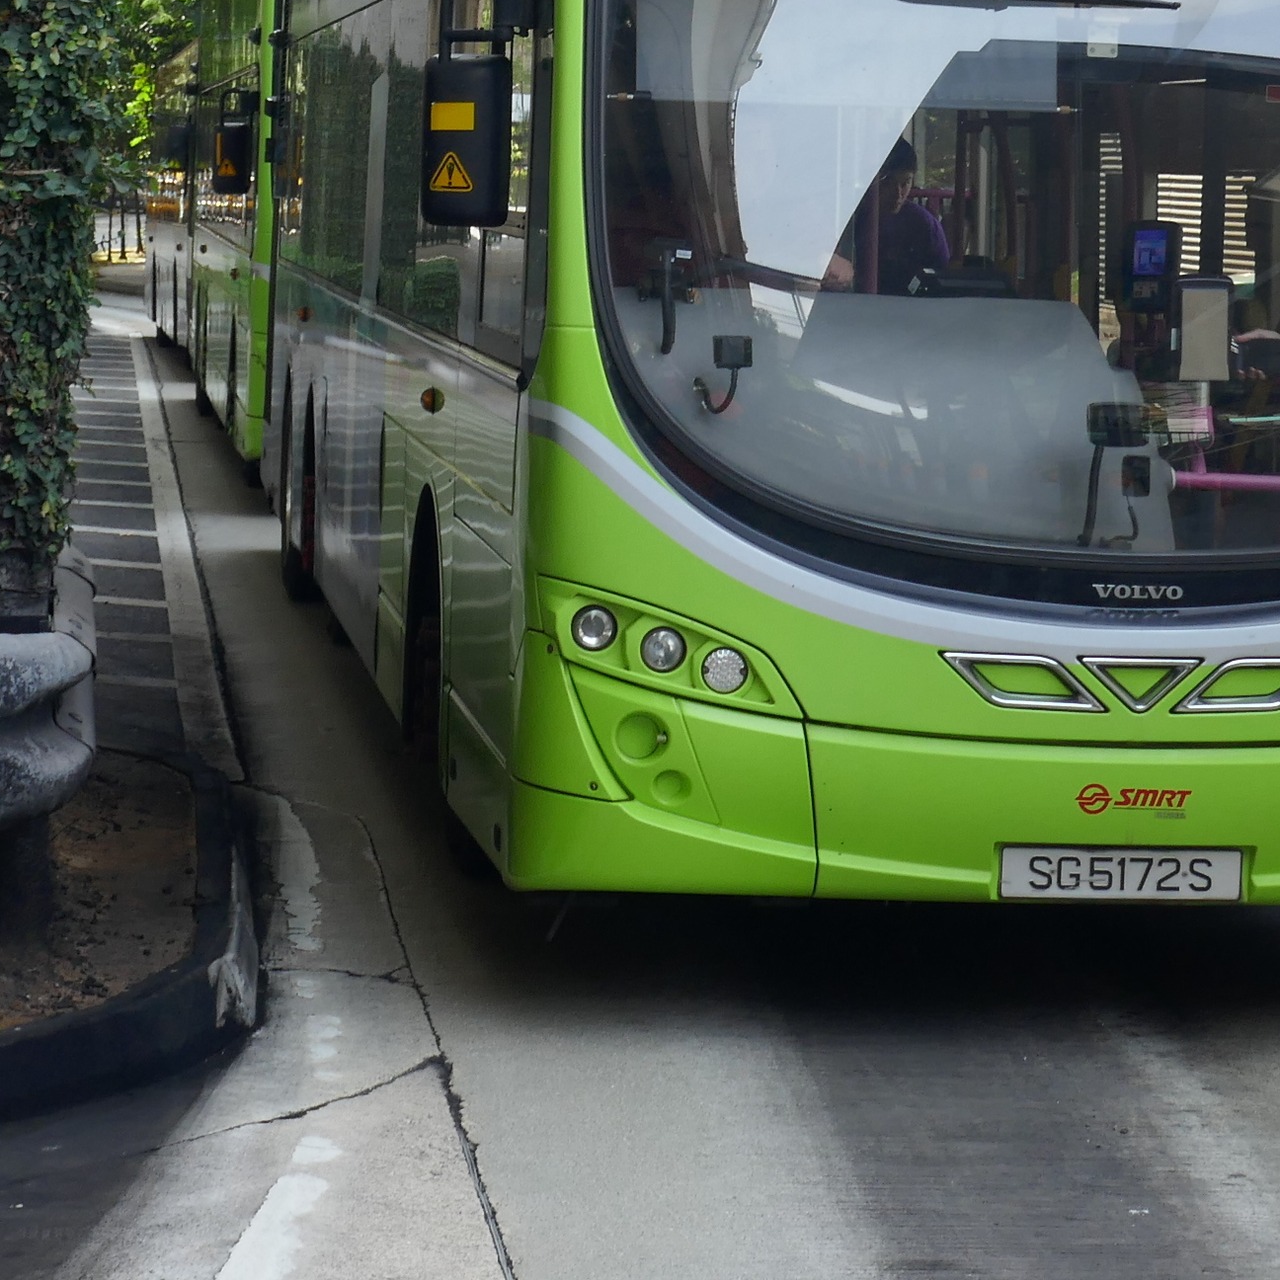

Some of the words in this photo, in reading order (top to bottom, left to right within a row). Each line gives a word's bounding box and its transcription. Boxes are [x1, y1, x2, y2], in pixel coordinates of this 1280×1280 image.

[1092, 584, 1184, 600] VOLVO
[1114, 788, 1193, 808] SMRT
[1028, 855, 1213, 892] SG5172S
